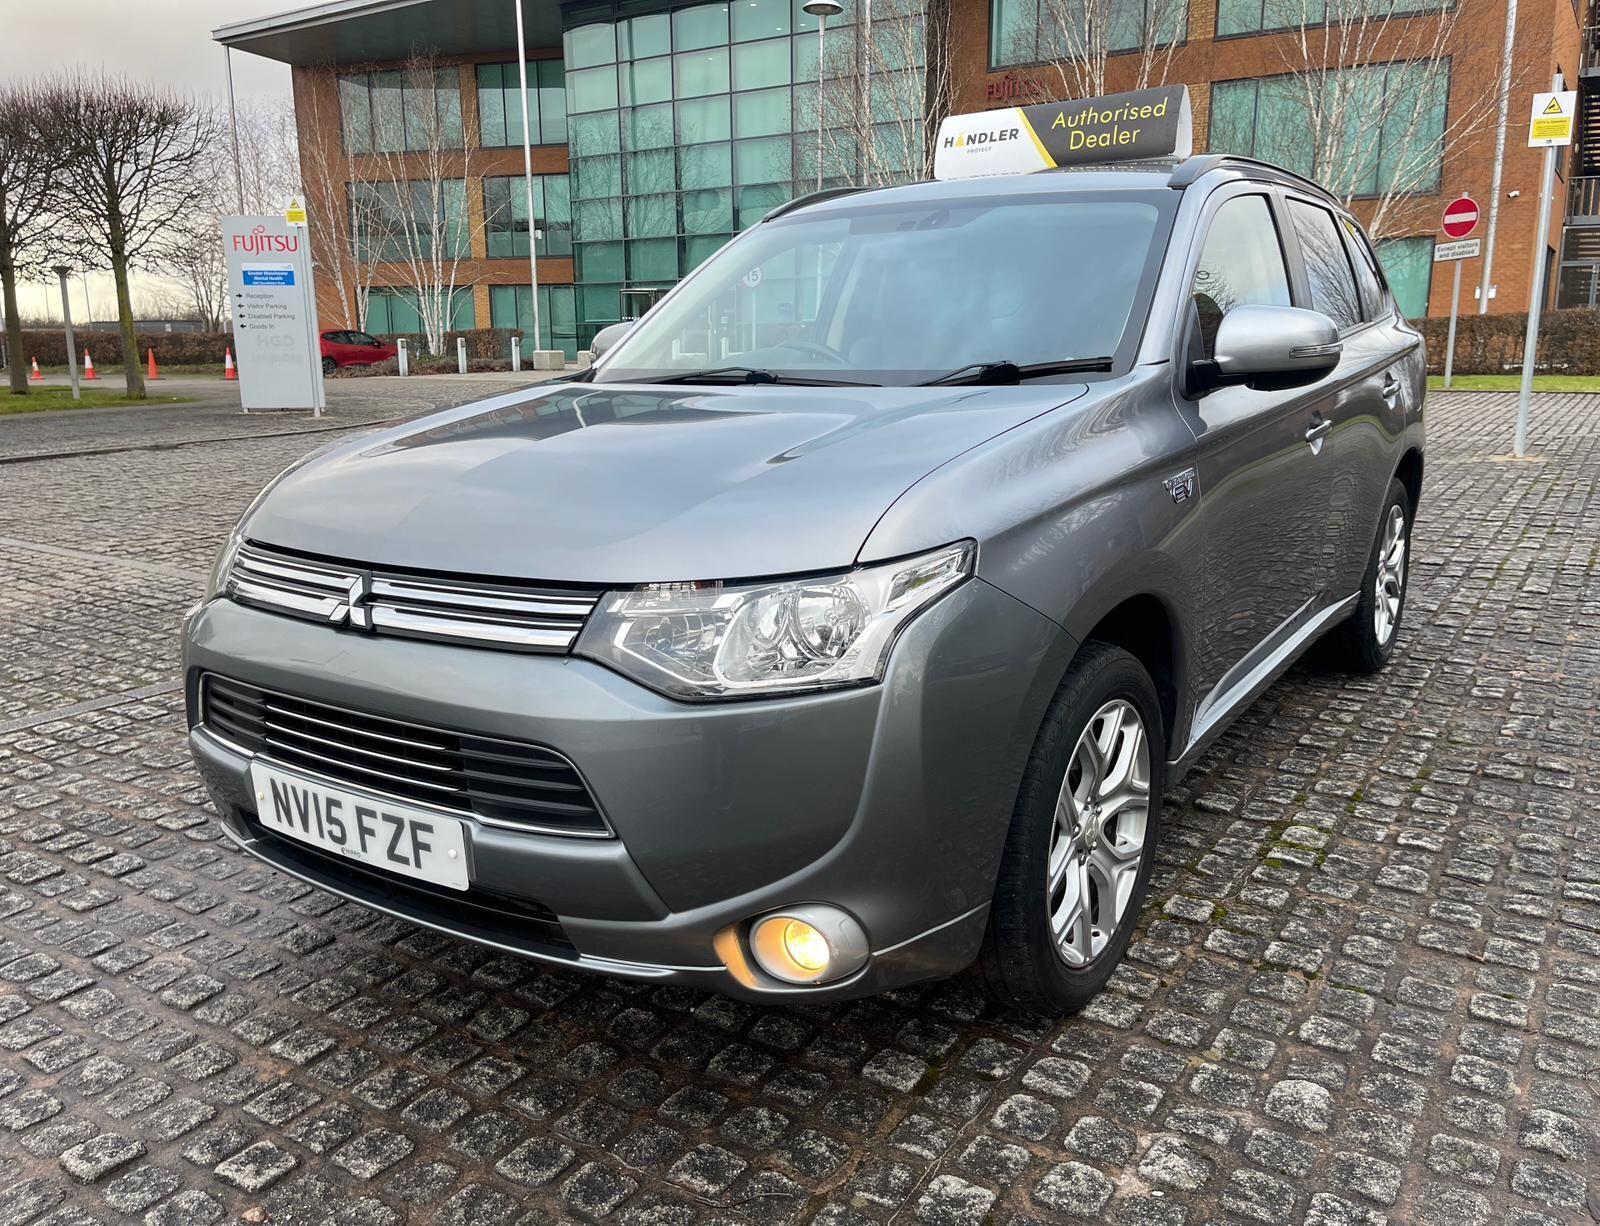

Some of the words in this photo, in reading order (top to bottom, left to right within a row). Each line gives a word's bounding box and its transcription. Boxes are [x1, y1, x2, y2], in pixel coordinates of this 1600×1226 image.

[1051, 96, 1169, 130] Authorised
[943, 128, 1020, 149] HANDLER
[1069, 124, 1141, 151] Dealer
[966, 146, 993, 154] PROTECT
[232, 225, 299, 256] FUJITSU
[1436, 245, 1457, 253] Except
[1450, 249, 1475, 257] disabled
[269, 777, 348, 846] NV15
[354, 804, 435, 870] FZF
